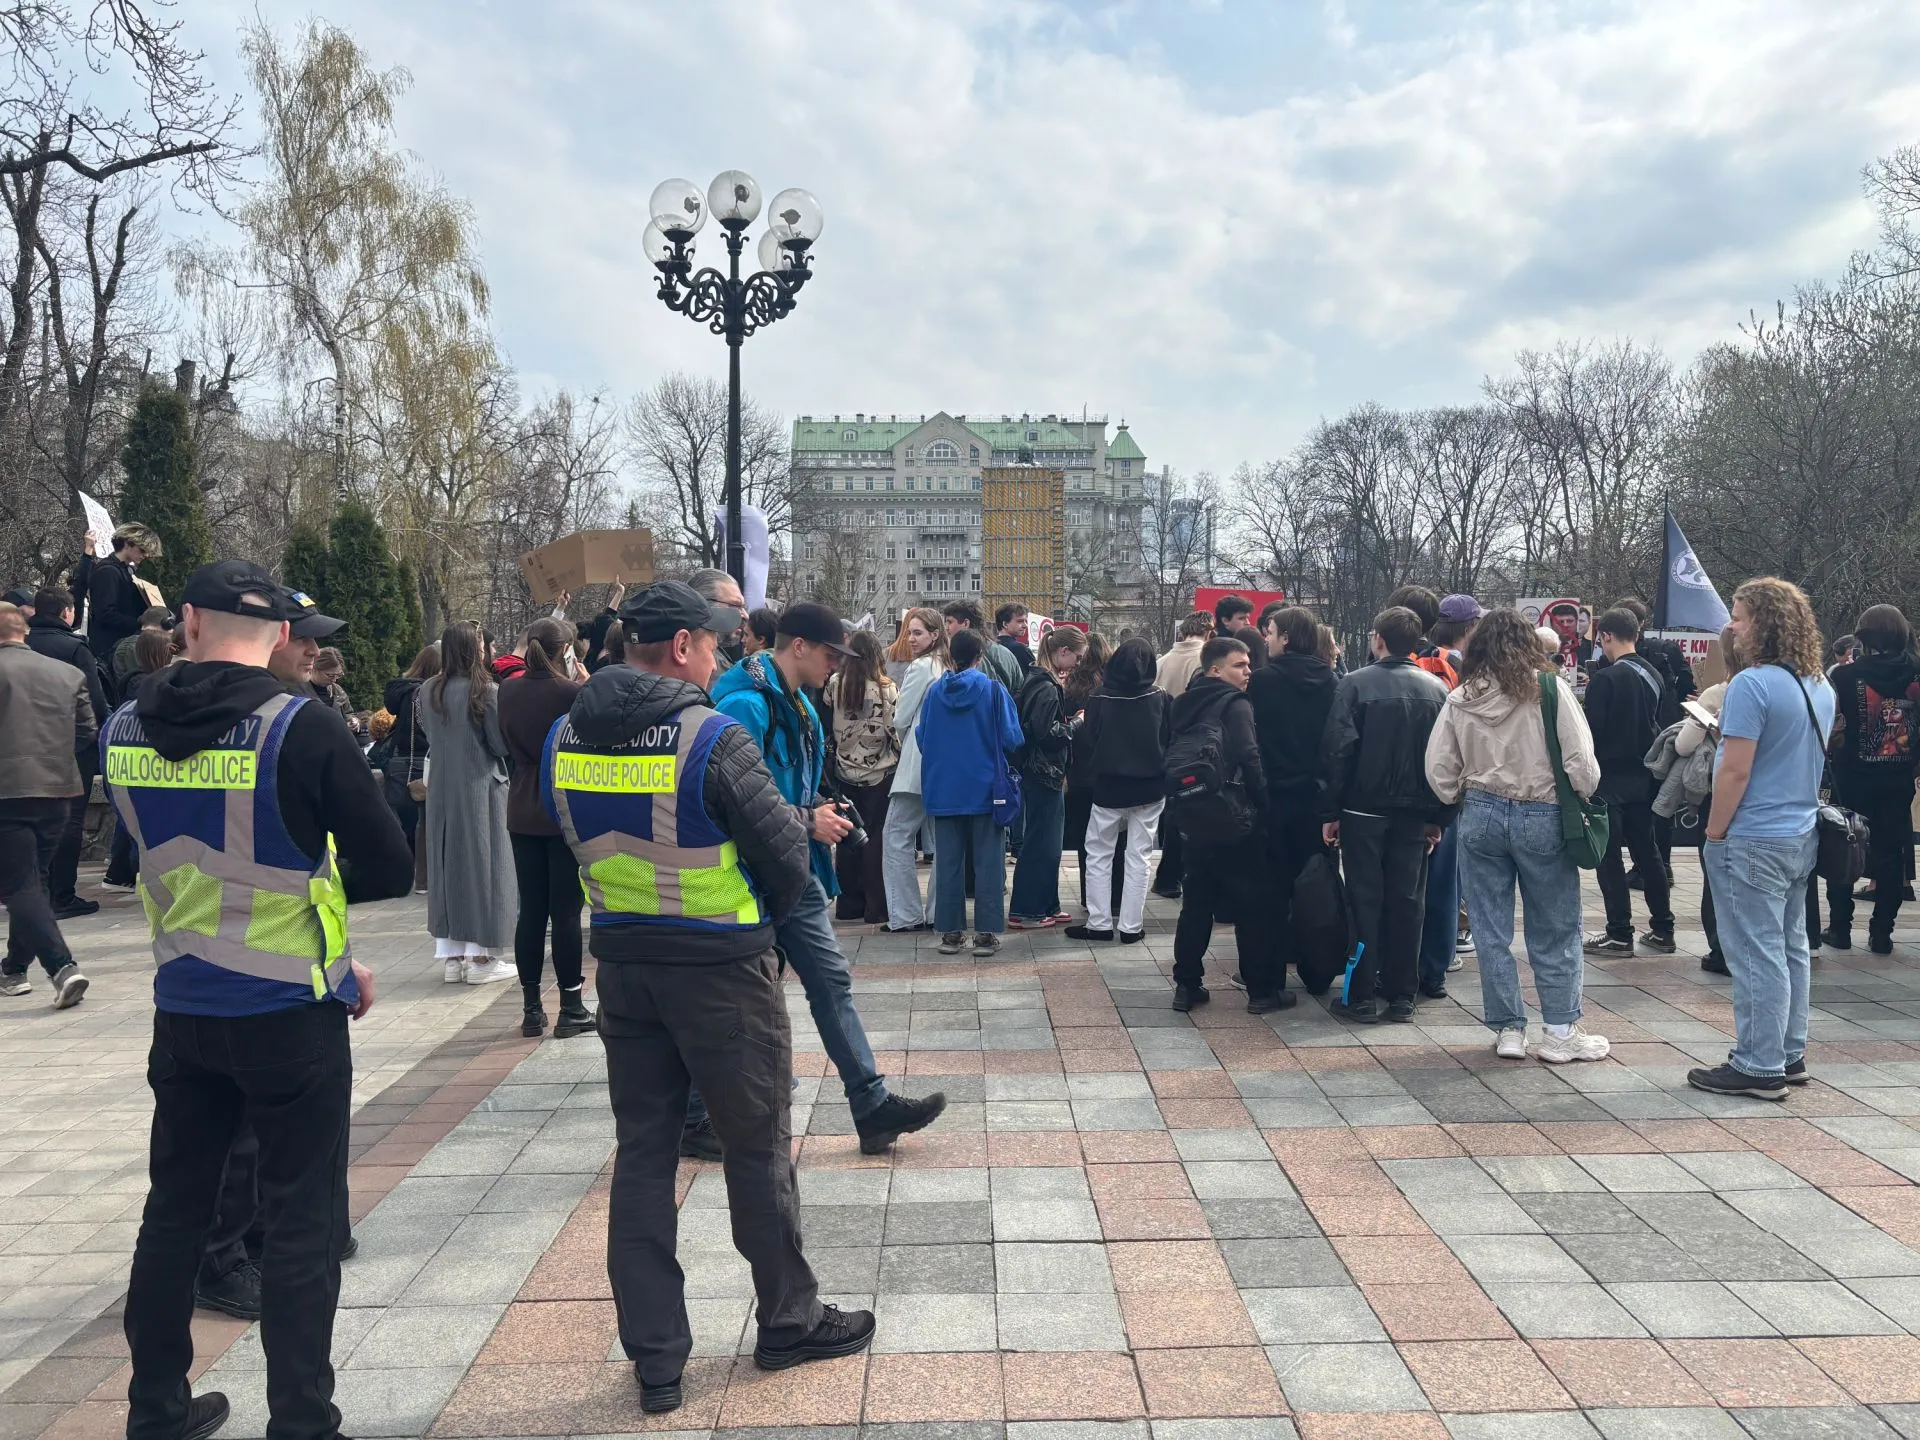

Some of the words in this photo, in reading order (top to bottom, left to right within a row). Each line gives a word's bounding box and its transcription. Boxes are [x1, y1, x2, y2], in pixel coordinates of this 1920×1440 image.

[108, 751, 185, 783] DIALOGUE
[189, 755, 251, 785] POLICE
[558, 758, 618, 787] DIALOGUE
[621, 762, 672, 788] POLICE
